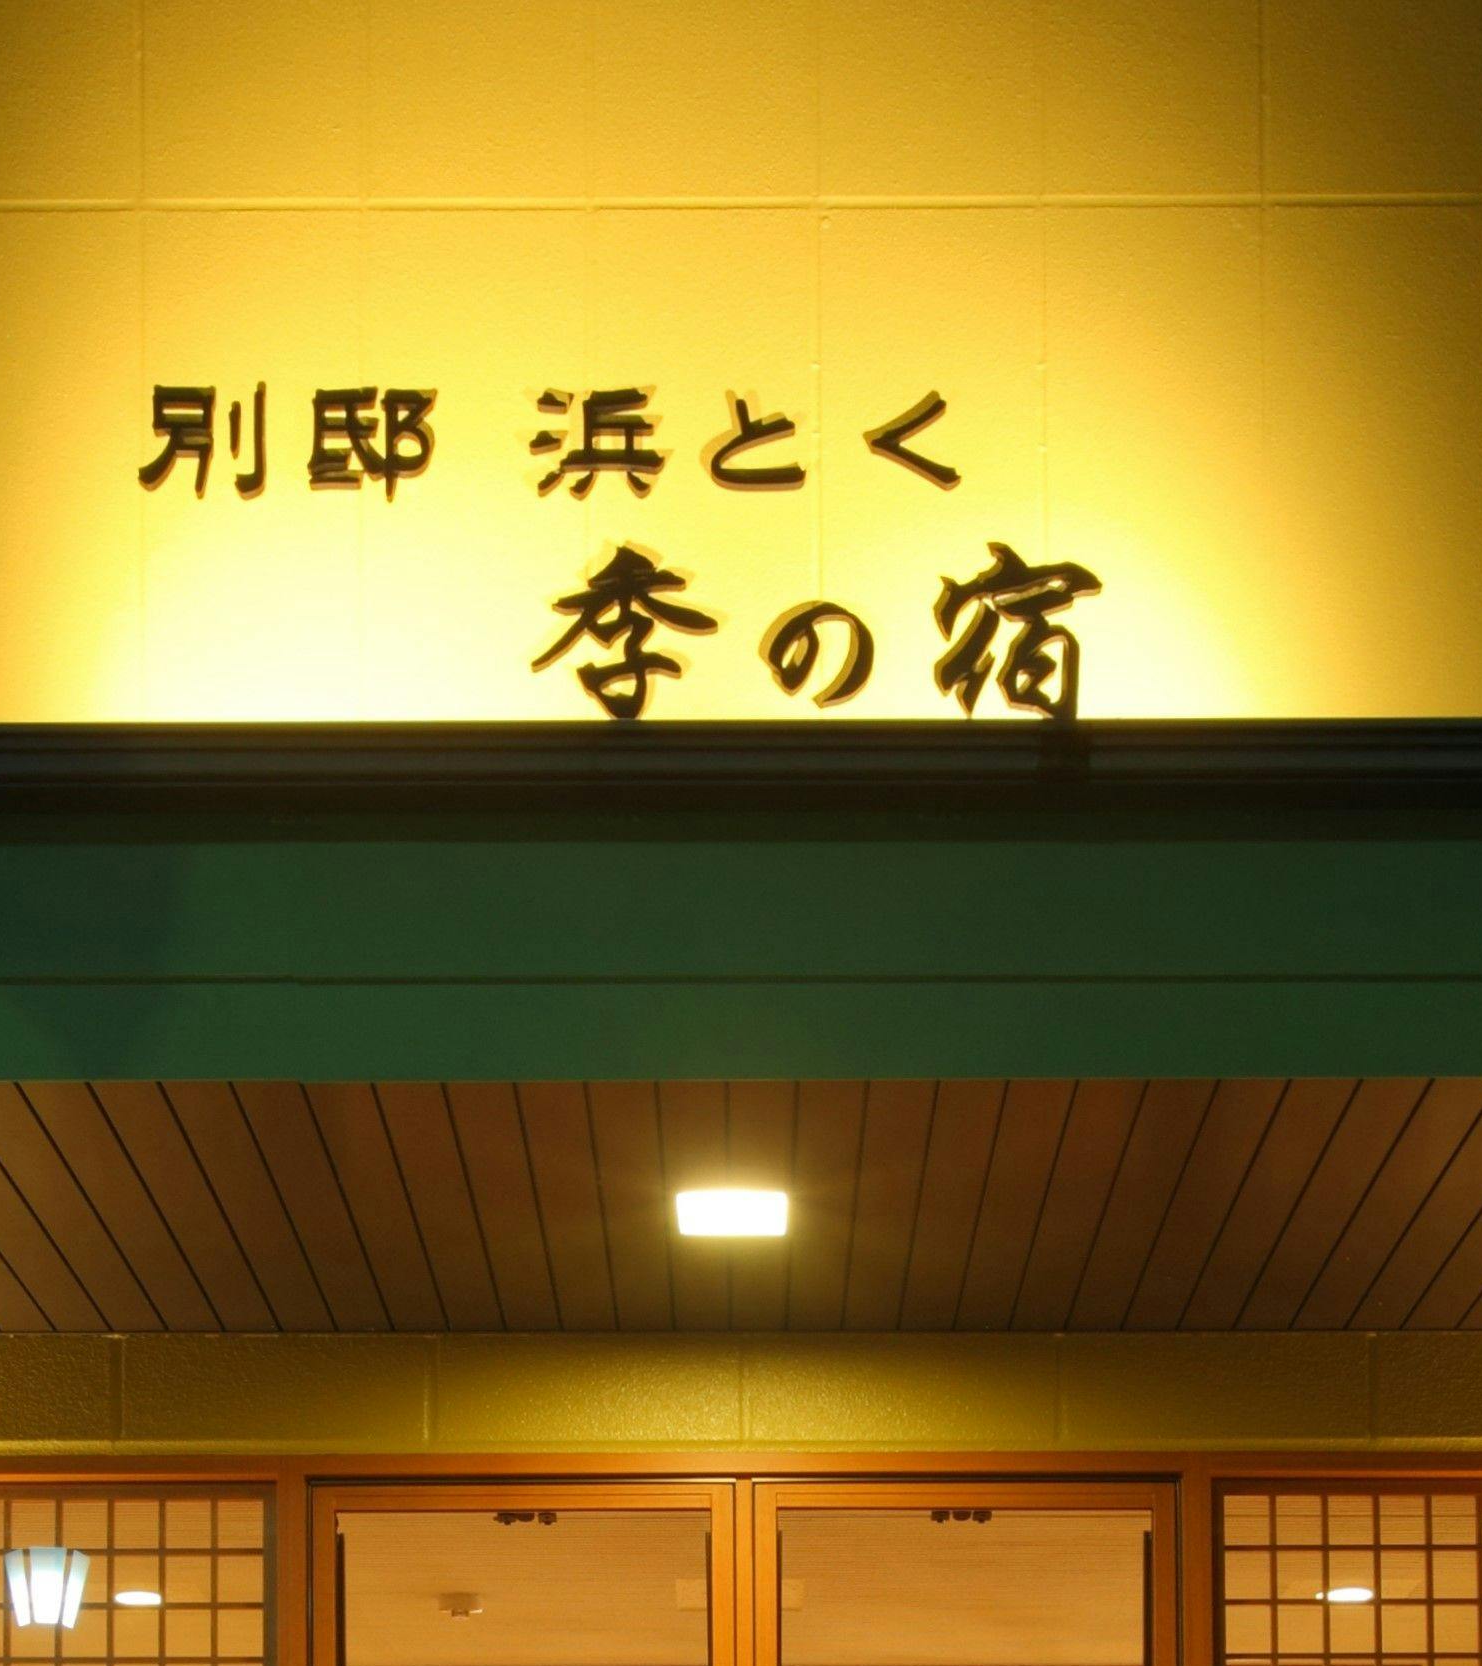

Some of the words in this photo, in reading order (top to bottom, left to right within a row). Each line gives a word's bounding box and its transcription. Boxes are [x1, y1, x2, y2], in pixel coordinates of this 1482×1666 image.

[138, 381, 437, 498] 別邸
[529, 386, 961, 498] 浜とく
[531, 541, 1102, 718] 季の宿
